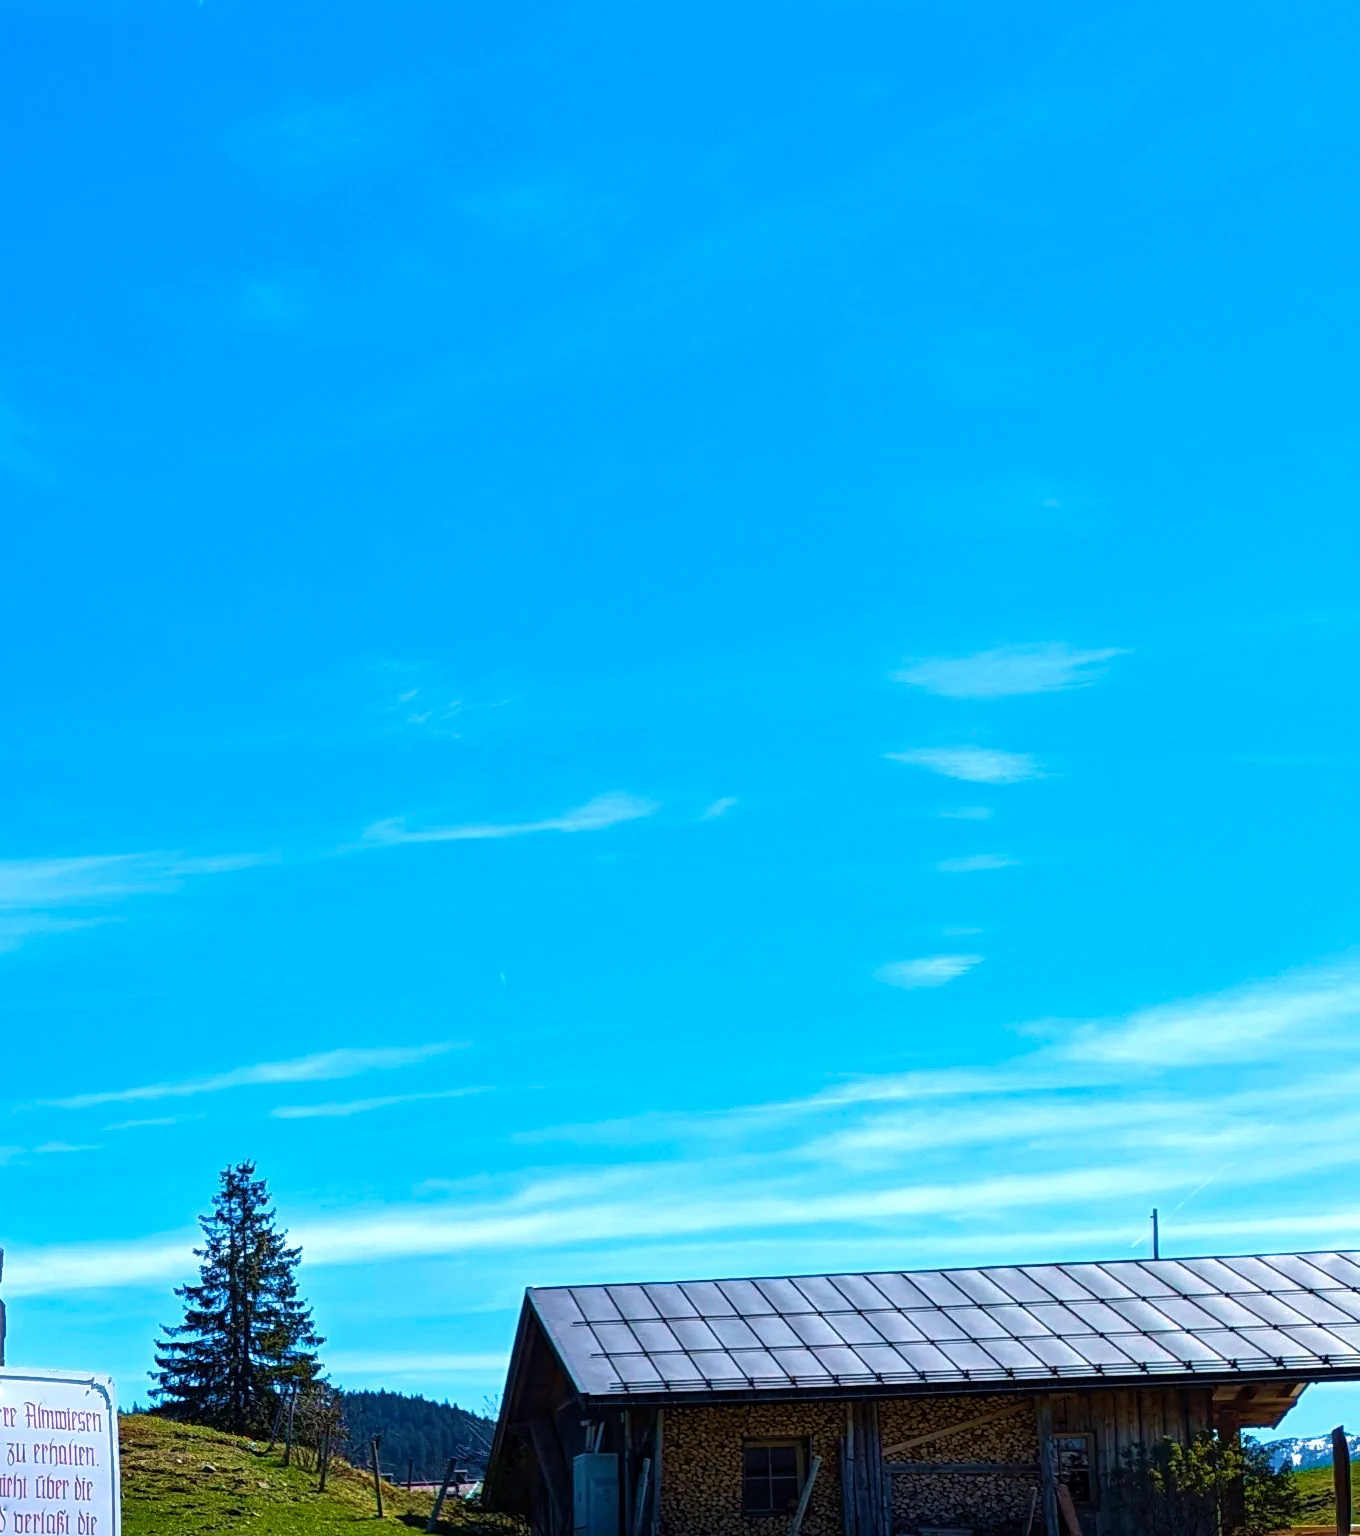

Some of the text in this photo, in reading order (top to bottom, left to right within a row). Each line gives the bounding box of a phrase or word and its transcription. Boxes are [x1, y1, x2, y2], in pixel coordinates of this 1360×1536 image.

[23, 1401, 103, 1433] Almwiesen
[6, 1441, 27, 1467] zu
[33, 1437, 100, 1468] erhalten.
[35, 1472, 70, 1501] über
[74, 1474, 94, 1502] die
[77, 1508, 98, 1536] die
